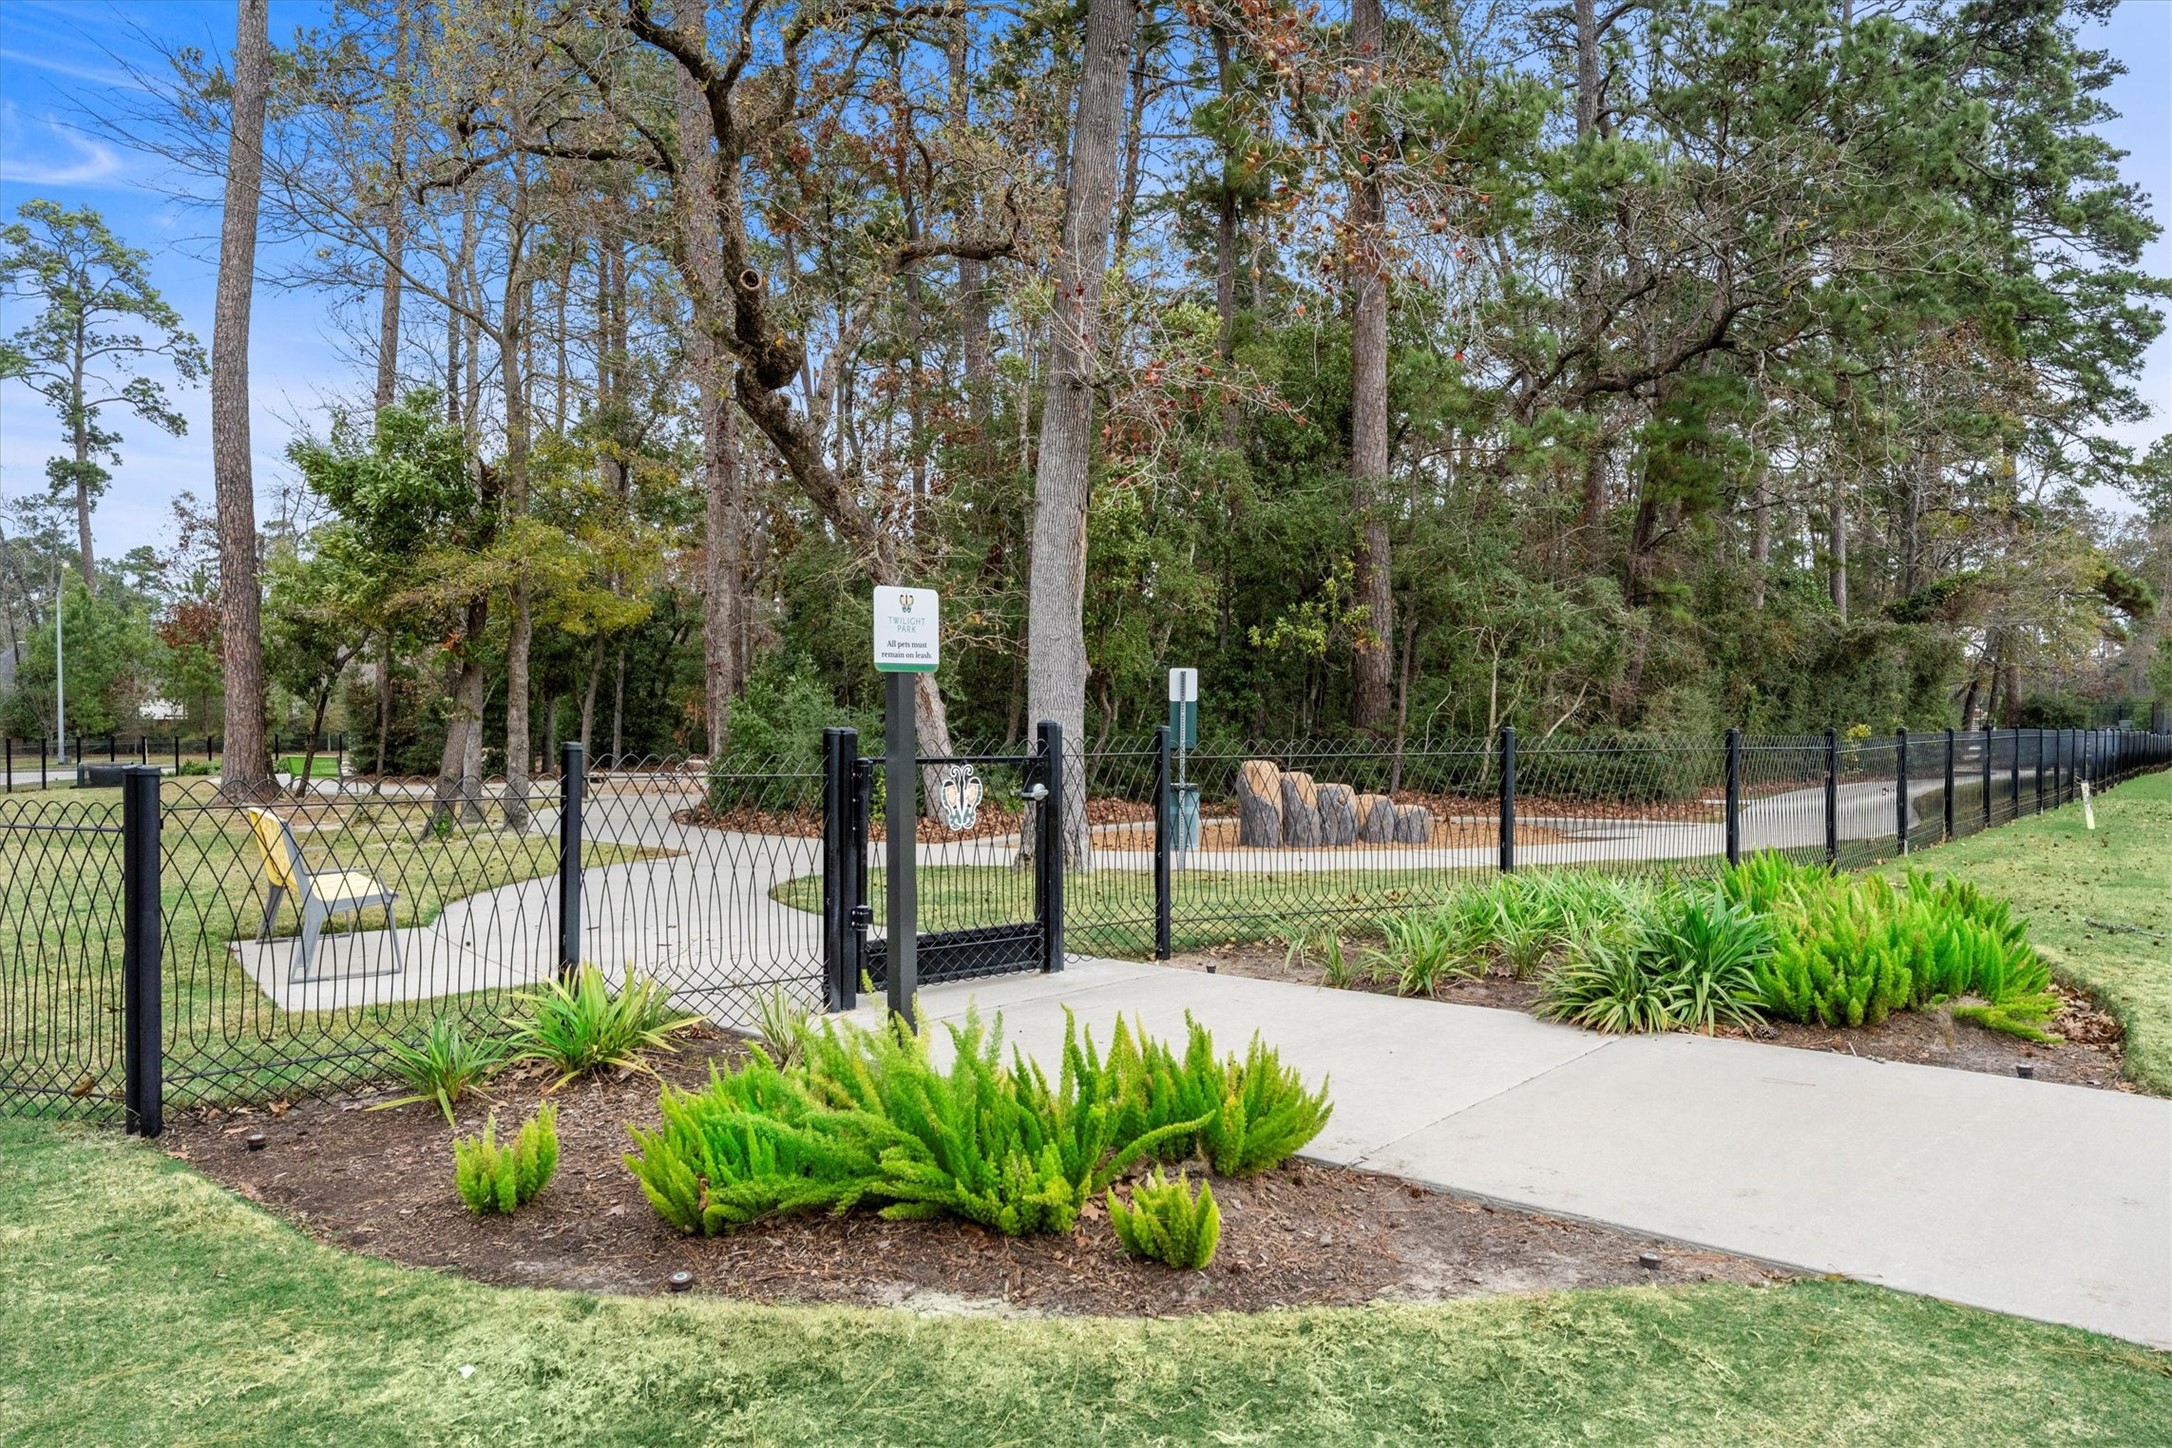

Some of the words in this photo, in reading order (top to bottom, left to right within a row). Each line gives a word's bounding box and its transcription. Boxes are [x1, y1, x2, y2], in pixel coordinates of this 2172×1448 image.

[888, 616, 926, 625] TWILIGHT
[897, 625, 917, 633] PARK
[887, 640, 896, 648] All
[898, 641, 910, 649] pets
[881, 651, 905, 659] remain
